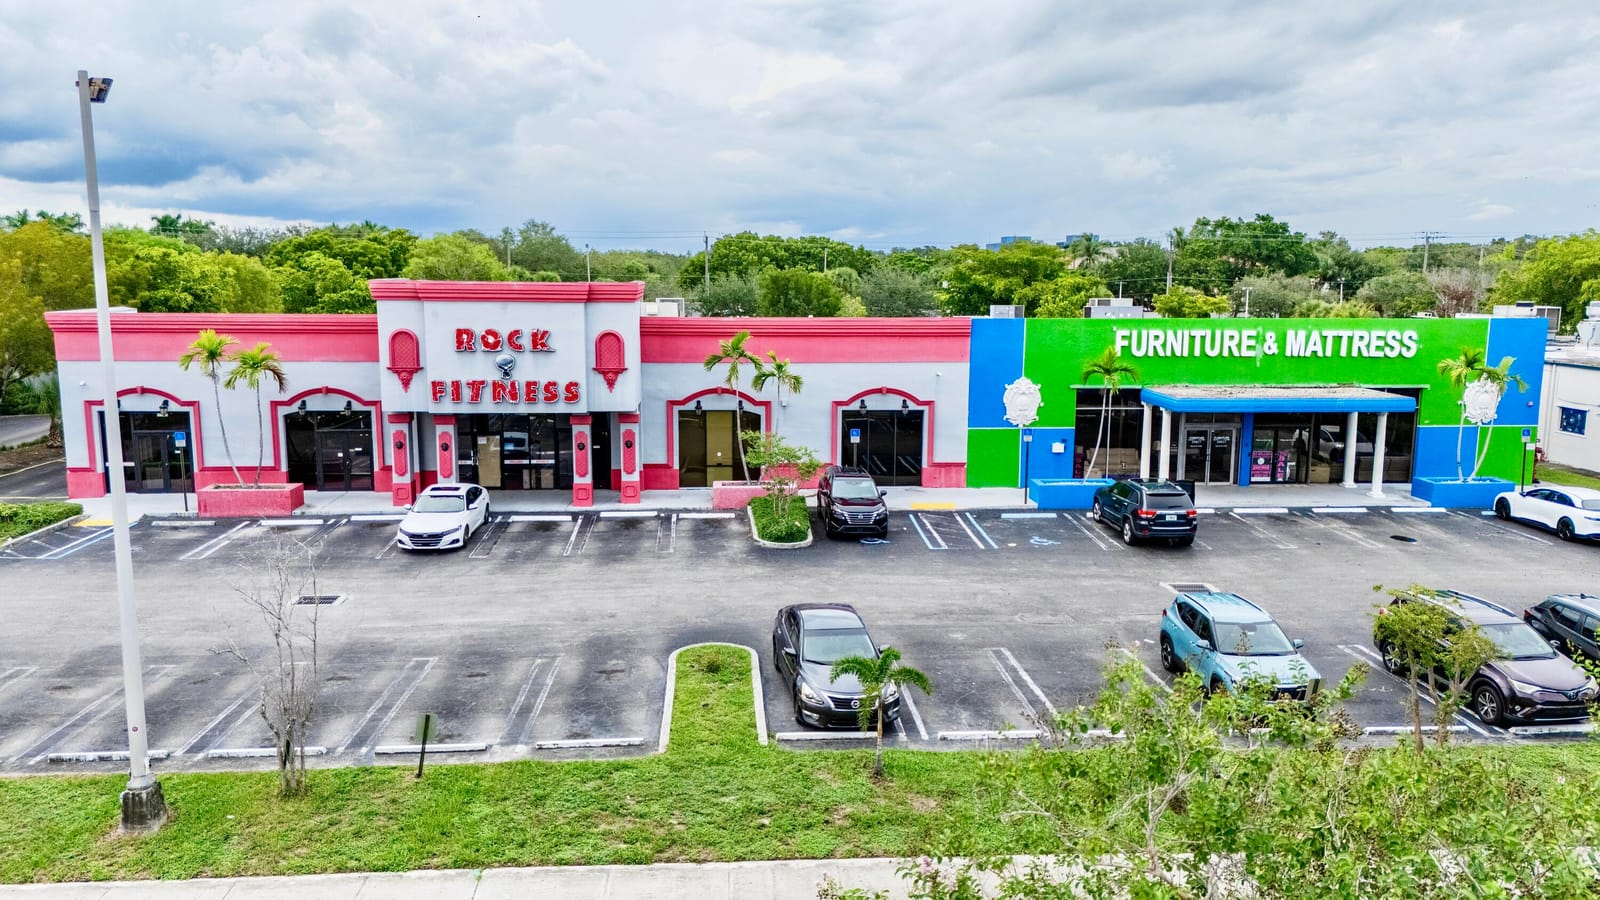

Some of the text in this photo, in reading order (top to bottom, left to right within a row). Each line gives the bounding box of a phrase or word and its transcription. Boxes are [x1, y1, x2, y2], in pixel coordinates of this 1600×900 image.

[456, 328, 555, 352] ROCK
[1115, 330, 1417, 357] FURNITURE & MATTRESS
[431, 380, 580, 403] FITNESS
